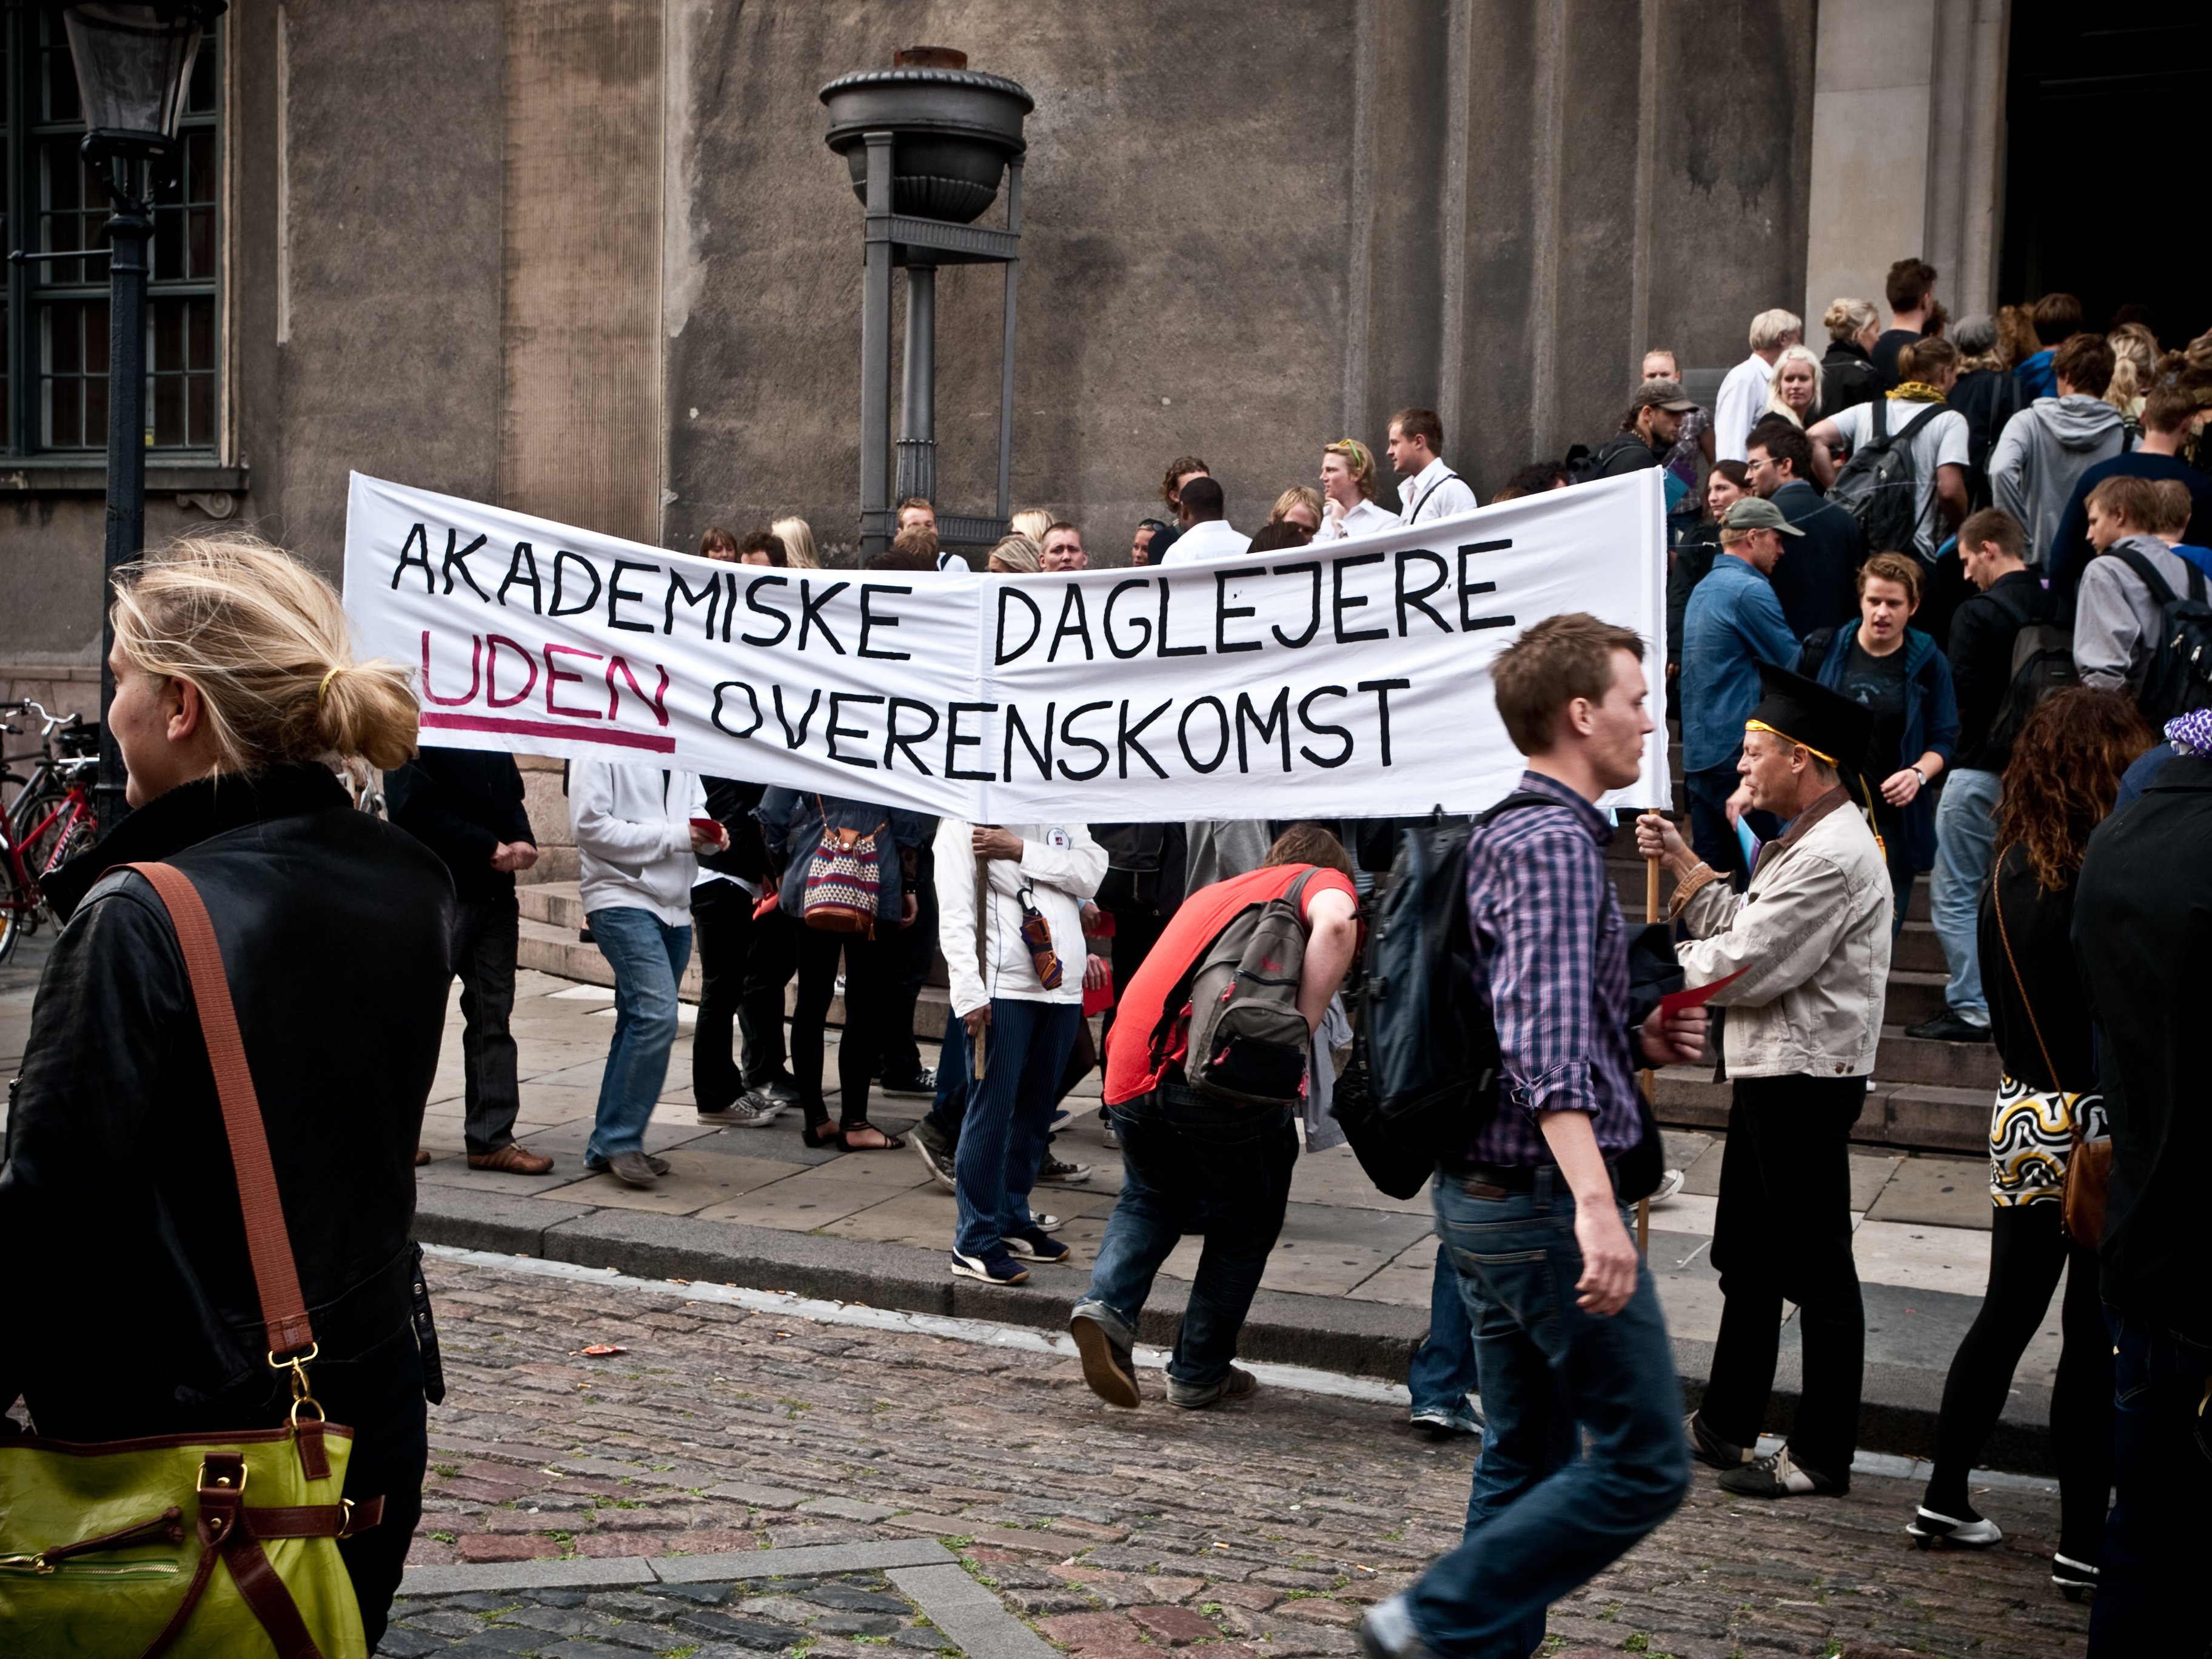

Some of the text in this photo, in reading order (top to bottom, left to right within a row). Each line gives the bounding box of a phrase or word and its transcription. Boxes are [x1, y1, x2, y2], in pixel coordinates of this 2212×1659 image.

[391, 523, 1516, 666] AKADEMISKE DAGLEJERE
[421, 630, 1410, 783] UDEN OVERENSKOMST
